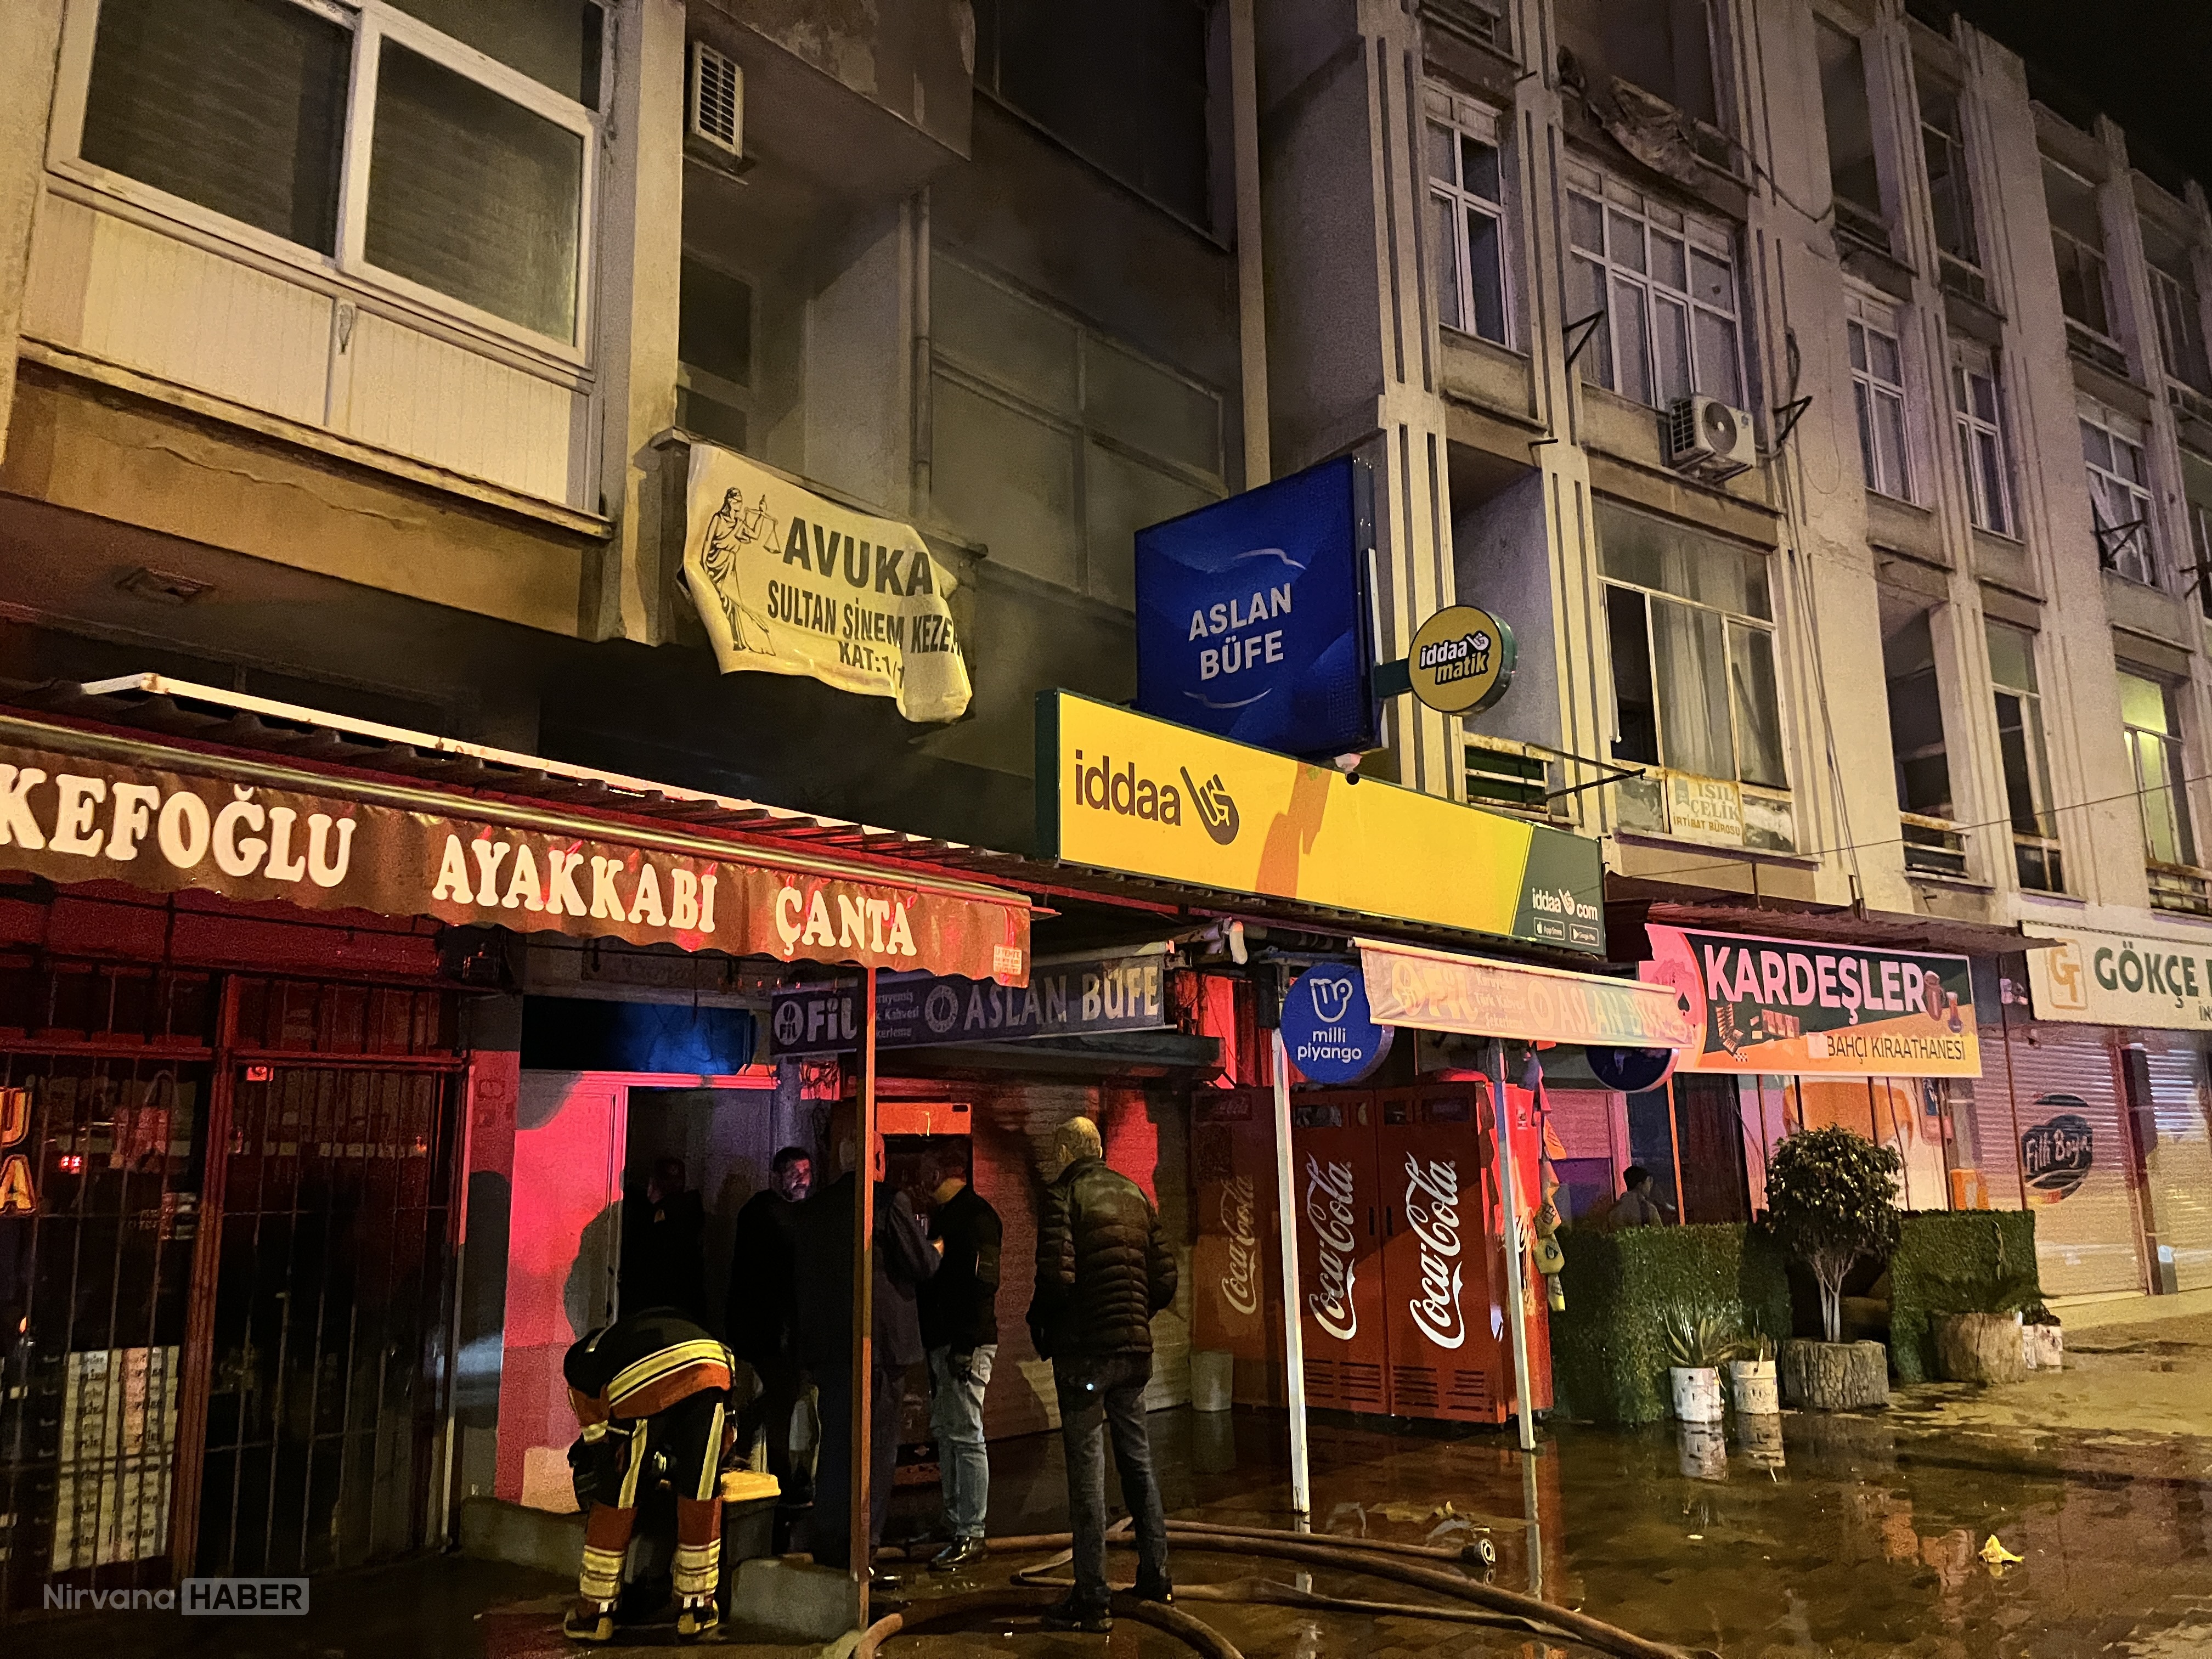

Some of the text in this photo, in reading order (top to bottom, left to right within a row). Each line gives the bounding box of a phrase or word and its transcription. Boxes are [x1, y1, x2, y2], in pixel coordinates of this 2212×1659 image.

[783, 516, 945, 596] AVUKA
[768, 580, 837, 636] SULTAN
[843, 596, 905, 650] SİNEM
[1188, 583, 1291, 641] ASLAN
[1200, 629, 1284, 680] BÜFE
[1420, 641, 1468, 667] iddaa
[1437, 652, 1487, 683] matik
[1075, 749, 1181, 826] iddaa
[1690, 799, 1742, 823] ÇELİK
[432, 834, 718, 933] AYAKKABI
[776, 885, 918, 956] ÇANTA
[1532, 887, 1599, 921] iddaa com
[963, 975, 1067, 1030] ASLAN
[1704, 944, 1926, 1025] KARDEŞLER
[2094, 941, 2199, 1008] GÖKÇE
[1313, 1026, 1346, 1043] milli
[1557, 985, 1625, 1036] ASLAN
[1297, 1042, 1362, 1063] piyango
[1306, 1152, 1358, 1340] Coca-Cola
[1406, 1152, 1465, 1349] Coca-Cola
